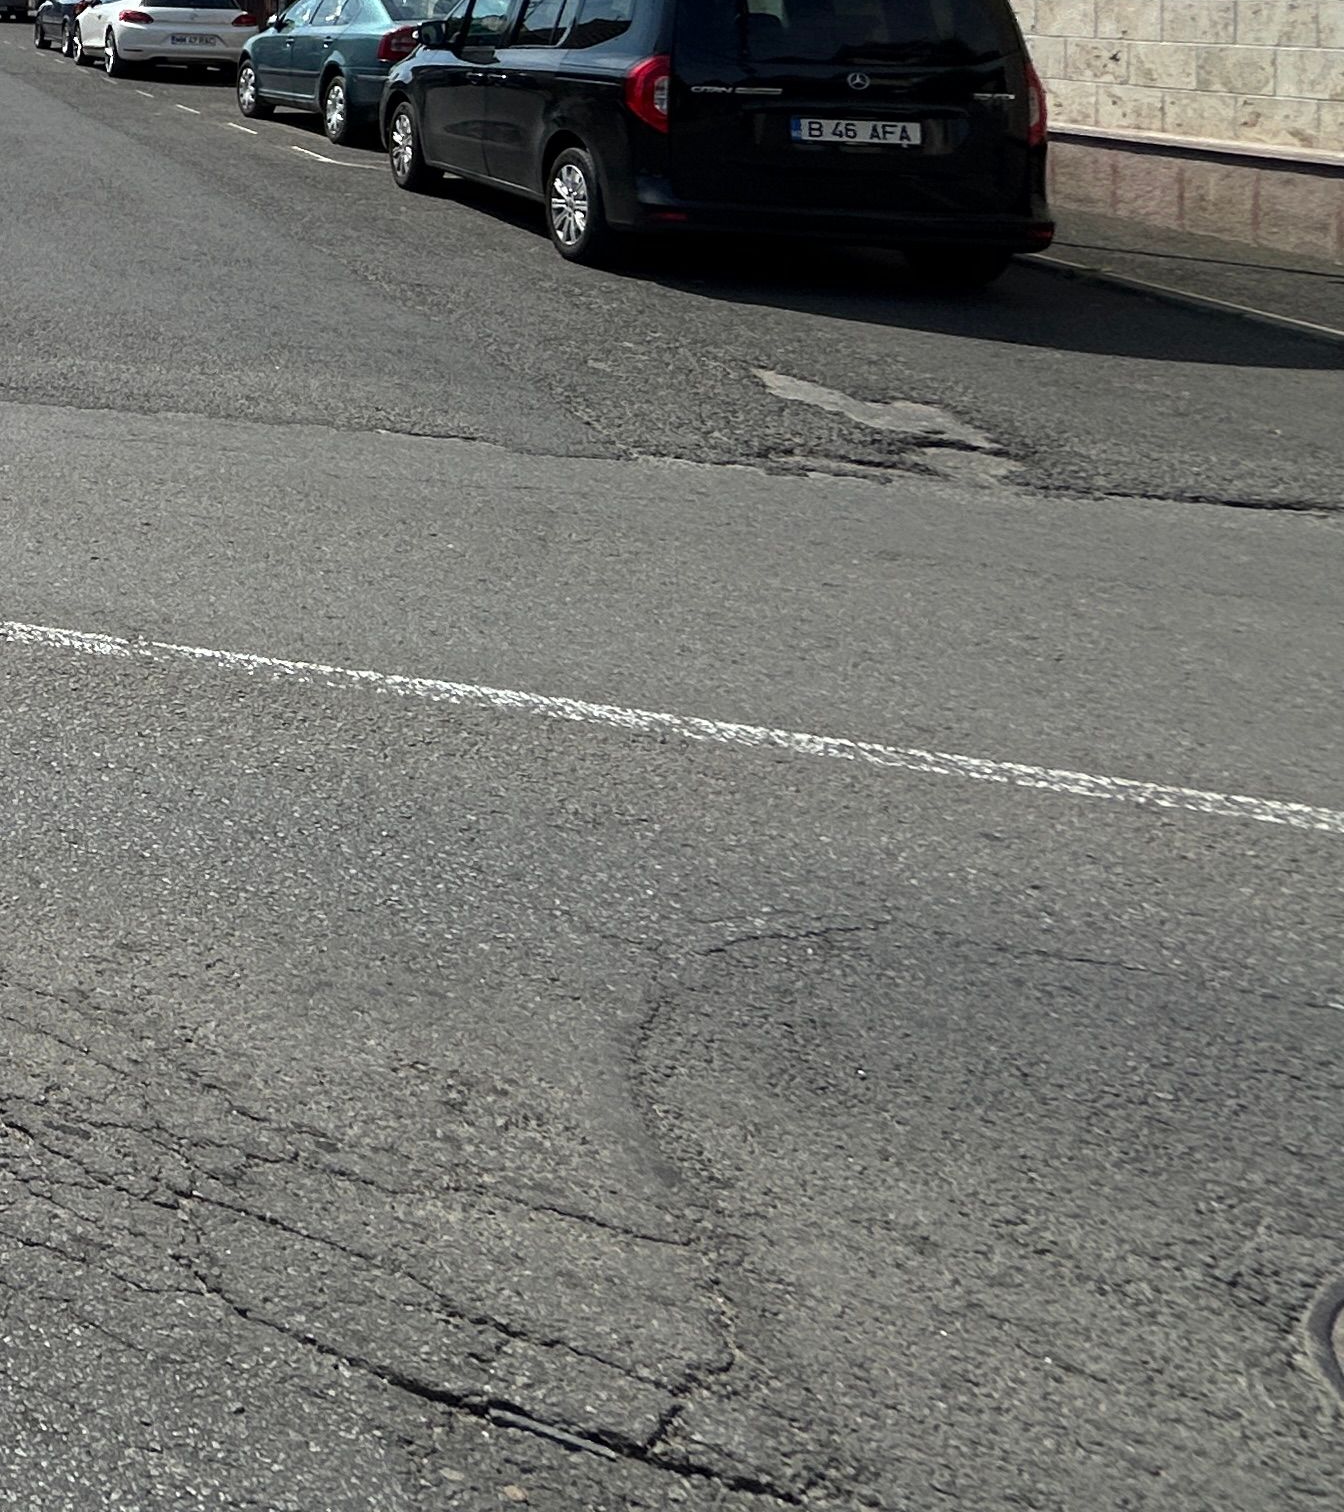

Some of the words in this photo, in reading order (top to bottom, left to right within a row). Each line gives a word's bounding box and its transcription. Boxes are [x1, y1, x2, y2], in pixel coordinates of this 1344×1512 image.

[807, 120, 824, 138] B
[831, 121, 858, 140] 46
[869, 123, 912, 142] AFA
